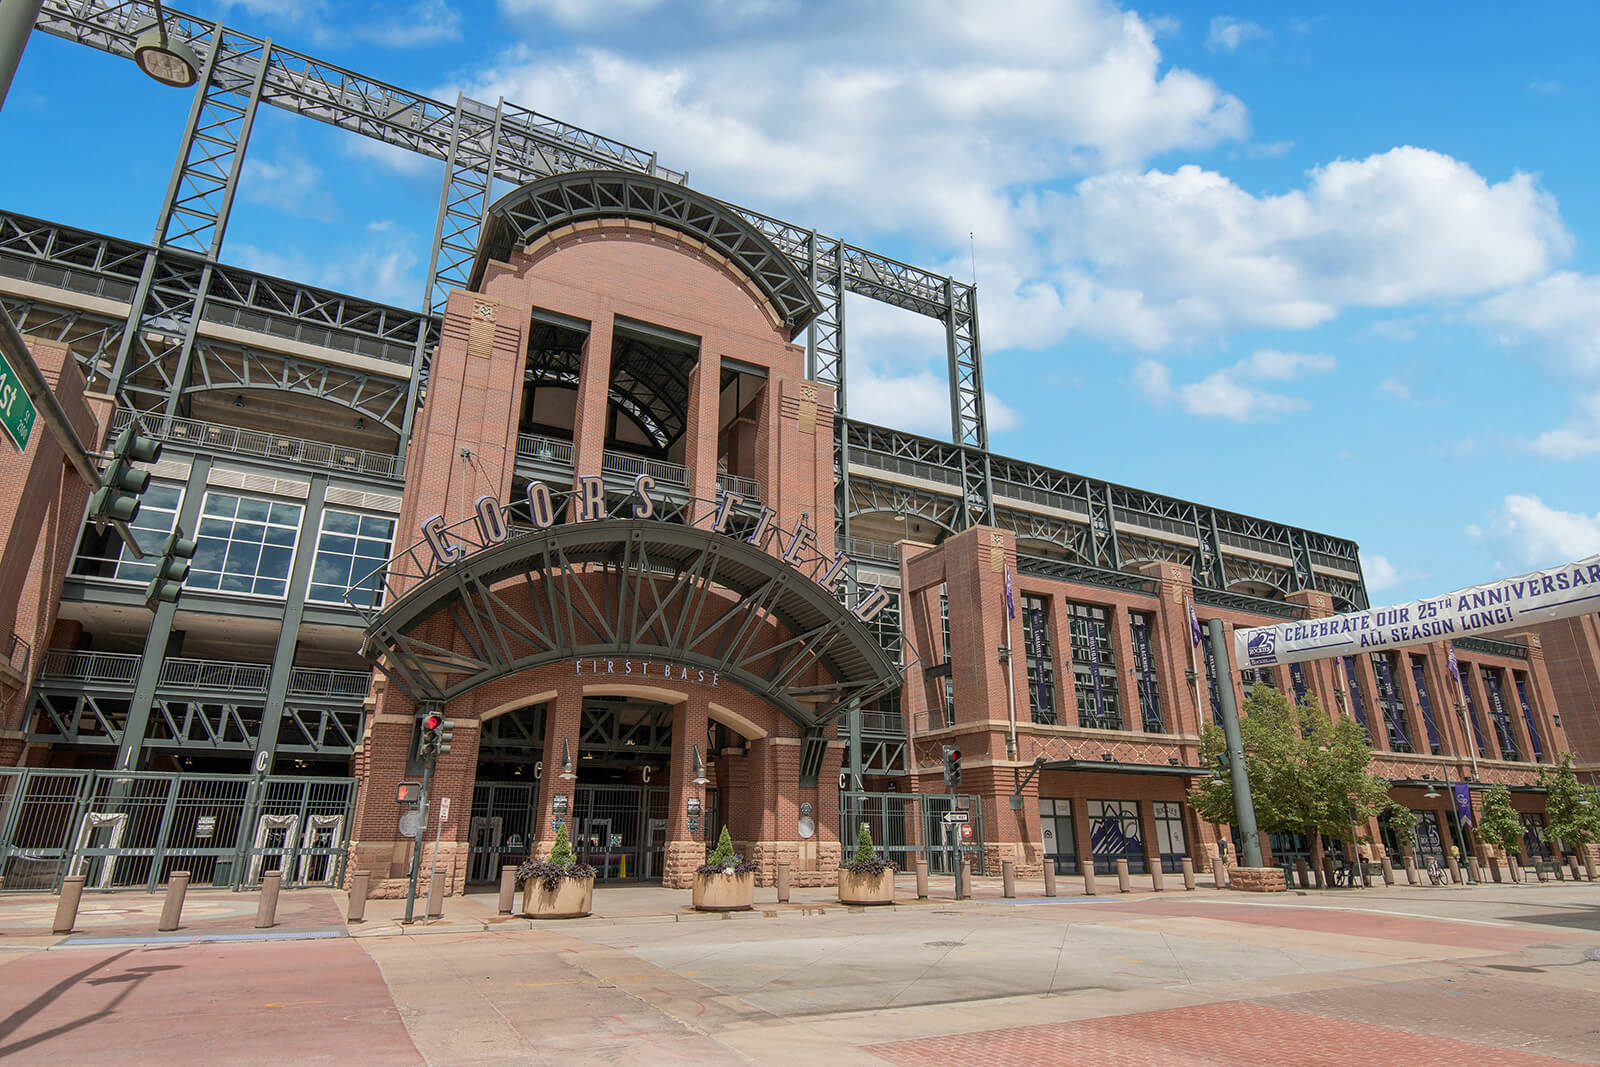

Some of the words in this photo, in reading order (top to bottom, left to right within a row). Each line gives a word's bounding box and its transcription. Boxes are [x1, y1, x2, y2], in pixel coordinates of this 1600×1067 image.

[421, 473, 656, 565] COORS
[712, 490, 890, 623] FIELD
[1284, 615, 1371, 642] CELEBRATE
[1376, 607, 1410, 627] OUR
[1418, 598, 1452, 620] 25TH
[1360, 631, 1387, 648] ALL
[1391, 618, 1455, 643] SEASON
[1460, 606, 1514, 631] LONG!
[1259, 633, 1274, 655] 25
[575, 659, 649, 675] FIRST
[663, 664, 720, 687] BASE
